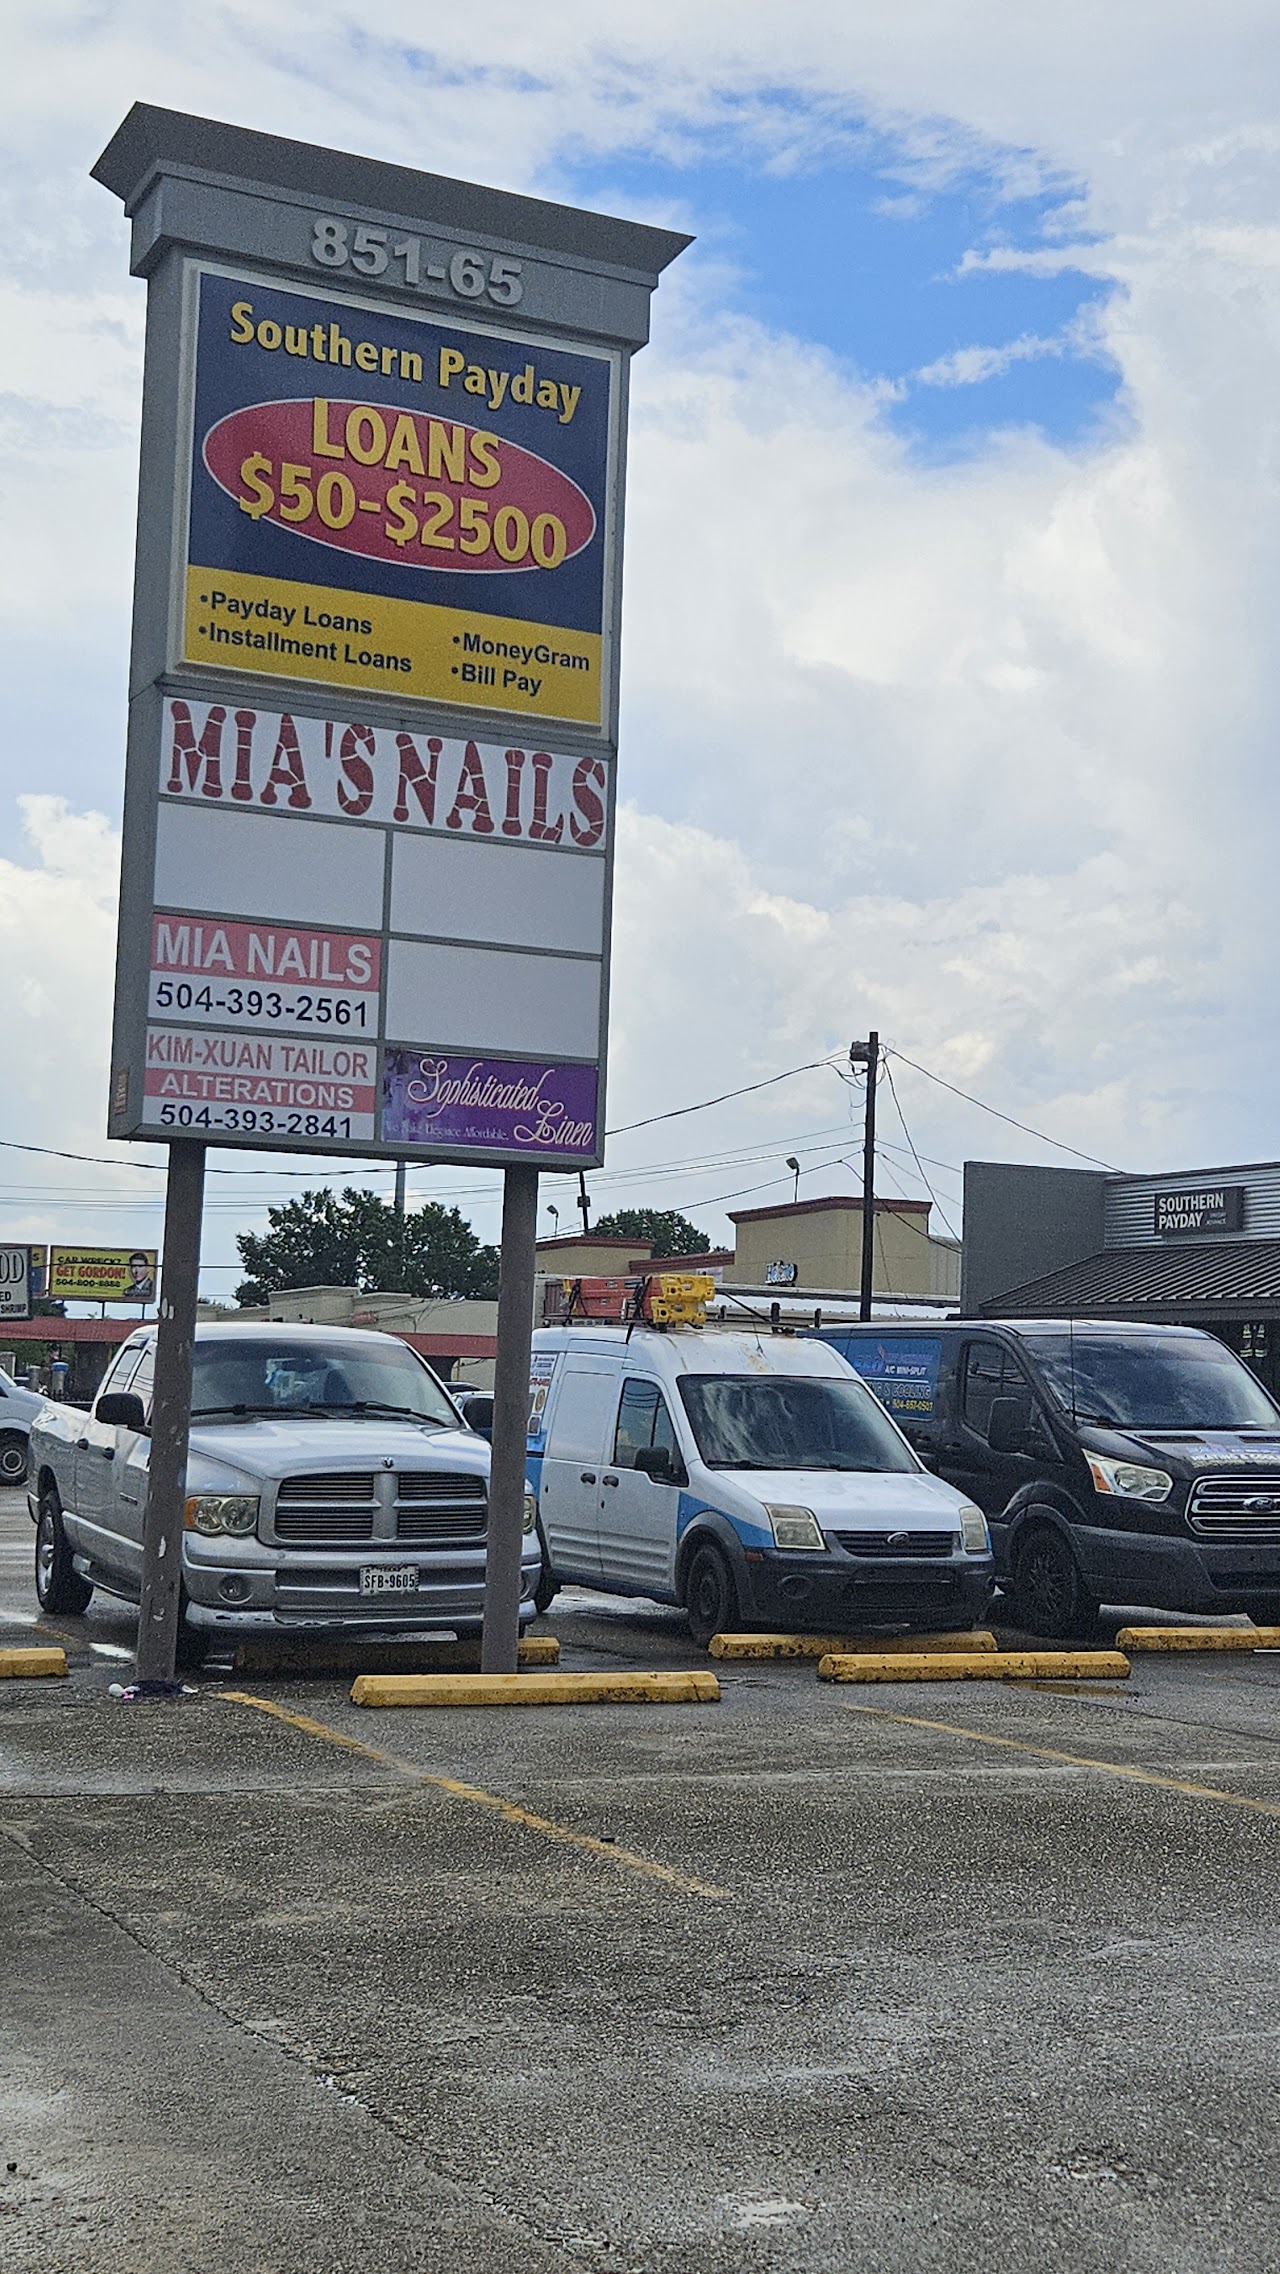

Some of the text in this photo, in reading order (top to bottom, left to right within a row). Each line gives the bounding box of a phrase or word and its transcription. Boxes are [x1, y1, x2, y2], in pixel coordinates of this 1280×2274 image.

[311, 218, 525, 307] 851-65
[230, 301, 582, 425] Southern Payday
[311, 396, 502, 490] LOANS
[238, 451, 568, 570] $50-$2500
[210, 589, 374, 635] Payday Loans
[208, 621, 413, 674] Installment Loans
[462, 632, 591, 672] MoneyGram
[461, 663, 543, 697] Bill Pay
[166, 699, 607, 848] MIA'S NAILS
[155, 922, 373, 985] MIA NAILS
[155, 981, 368, 1028] 504-393-2561
[147, 1033, 369, 1080] KIM-XUAN TAILOR
[159, 1072, 355, 1110] ALTERATIONS
[407, 1058, 555, 1118] Sophisticated
[159, 1103, 353, 1139] 504-393-2841
[513, 1100, 594, 1147] Linen
[1158, 1192, 1224, 1213] SOUTHERN
[1158, 1212, 1204, 1230] PAYDAY
[56, 1265, 126, 1280] GET GORDON!
